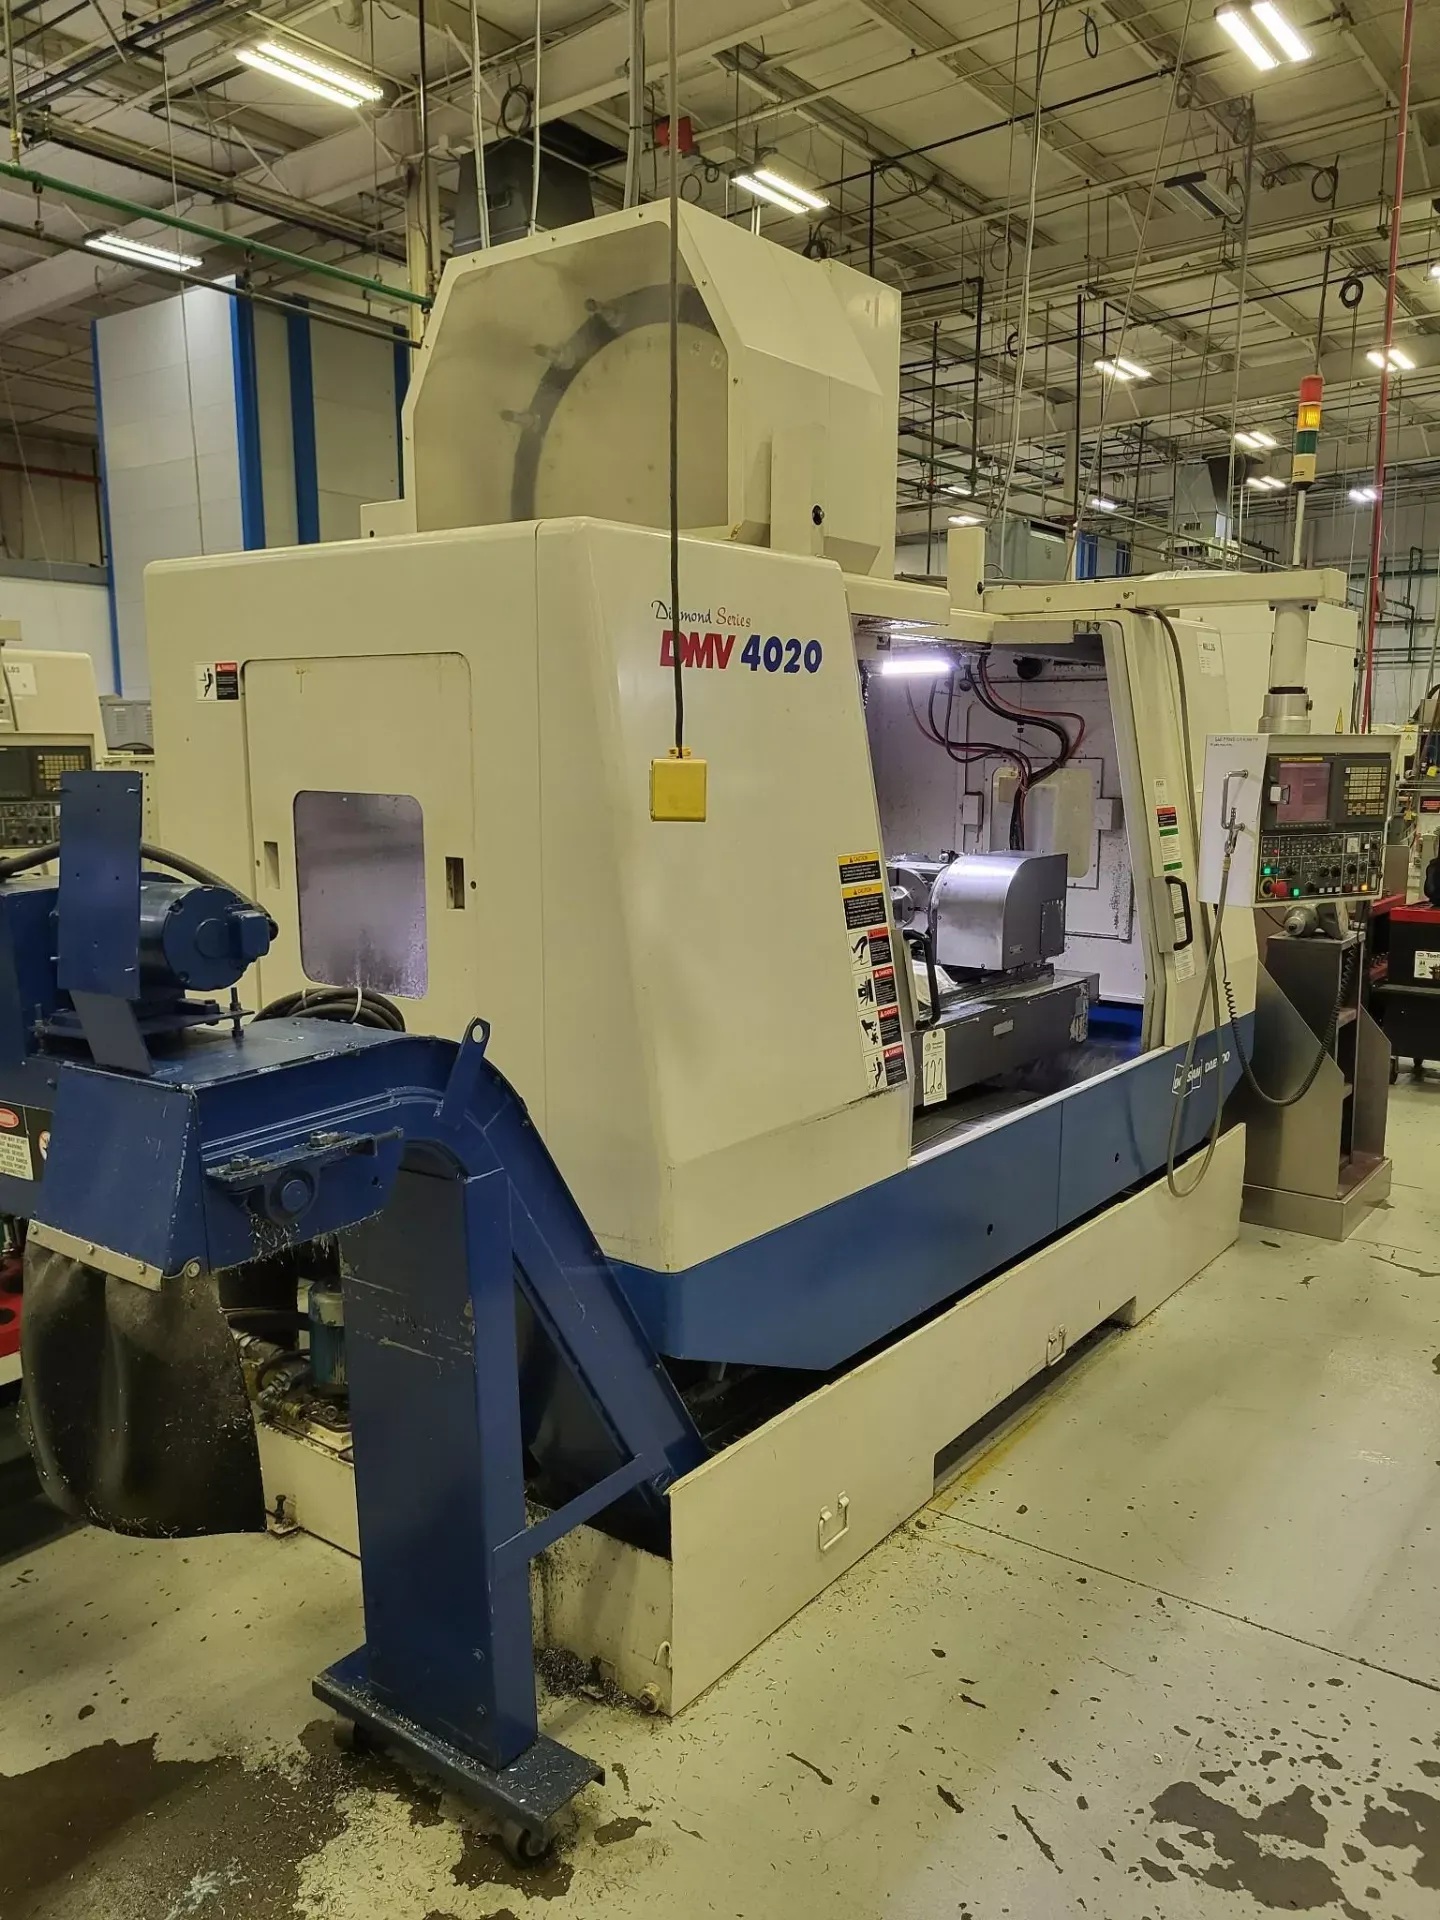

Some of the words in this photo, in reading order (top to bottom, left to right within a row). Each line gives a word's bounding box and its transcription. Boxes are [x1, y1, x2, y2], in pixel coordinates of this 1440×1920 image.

[651, 600, 712, 626] Dimond
[716, 606, 751, 629] Series
[660, 629, 736, 670] DMV
[741, 634, 823, 674] 4020
[924, 1057, 945, 1095] 122
